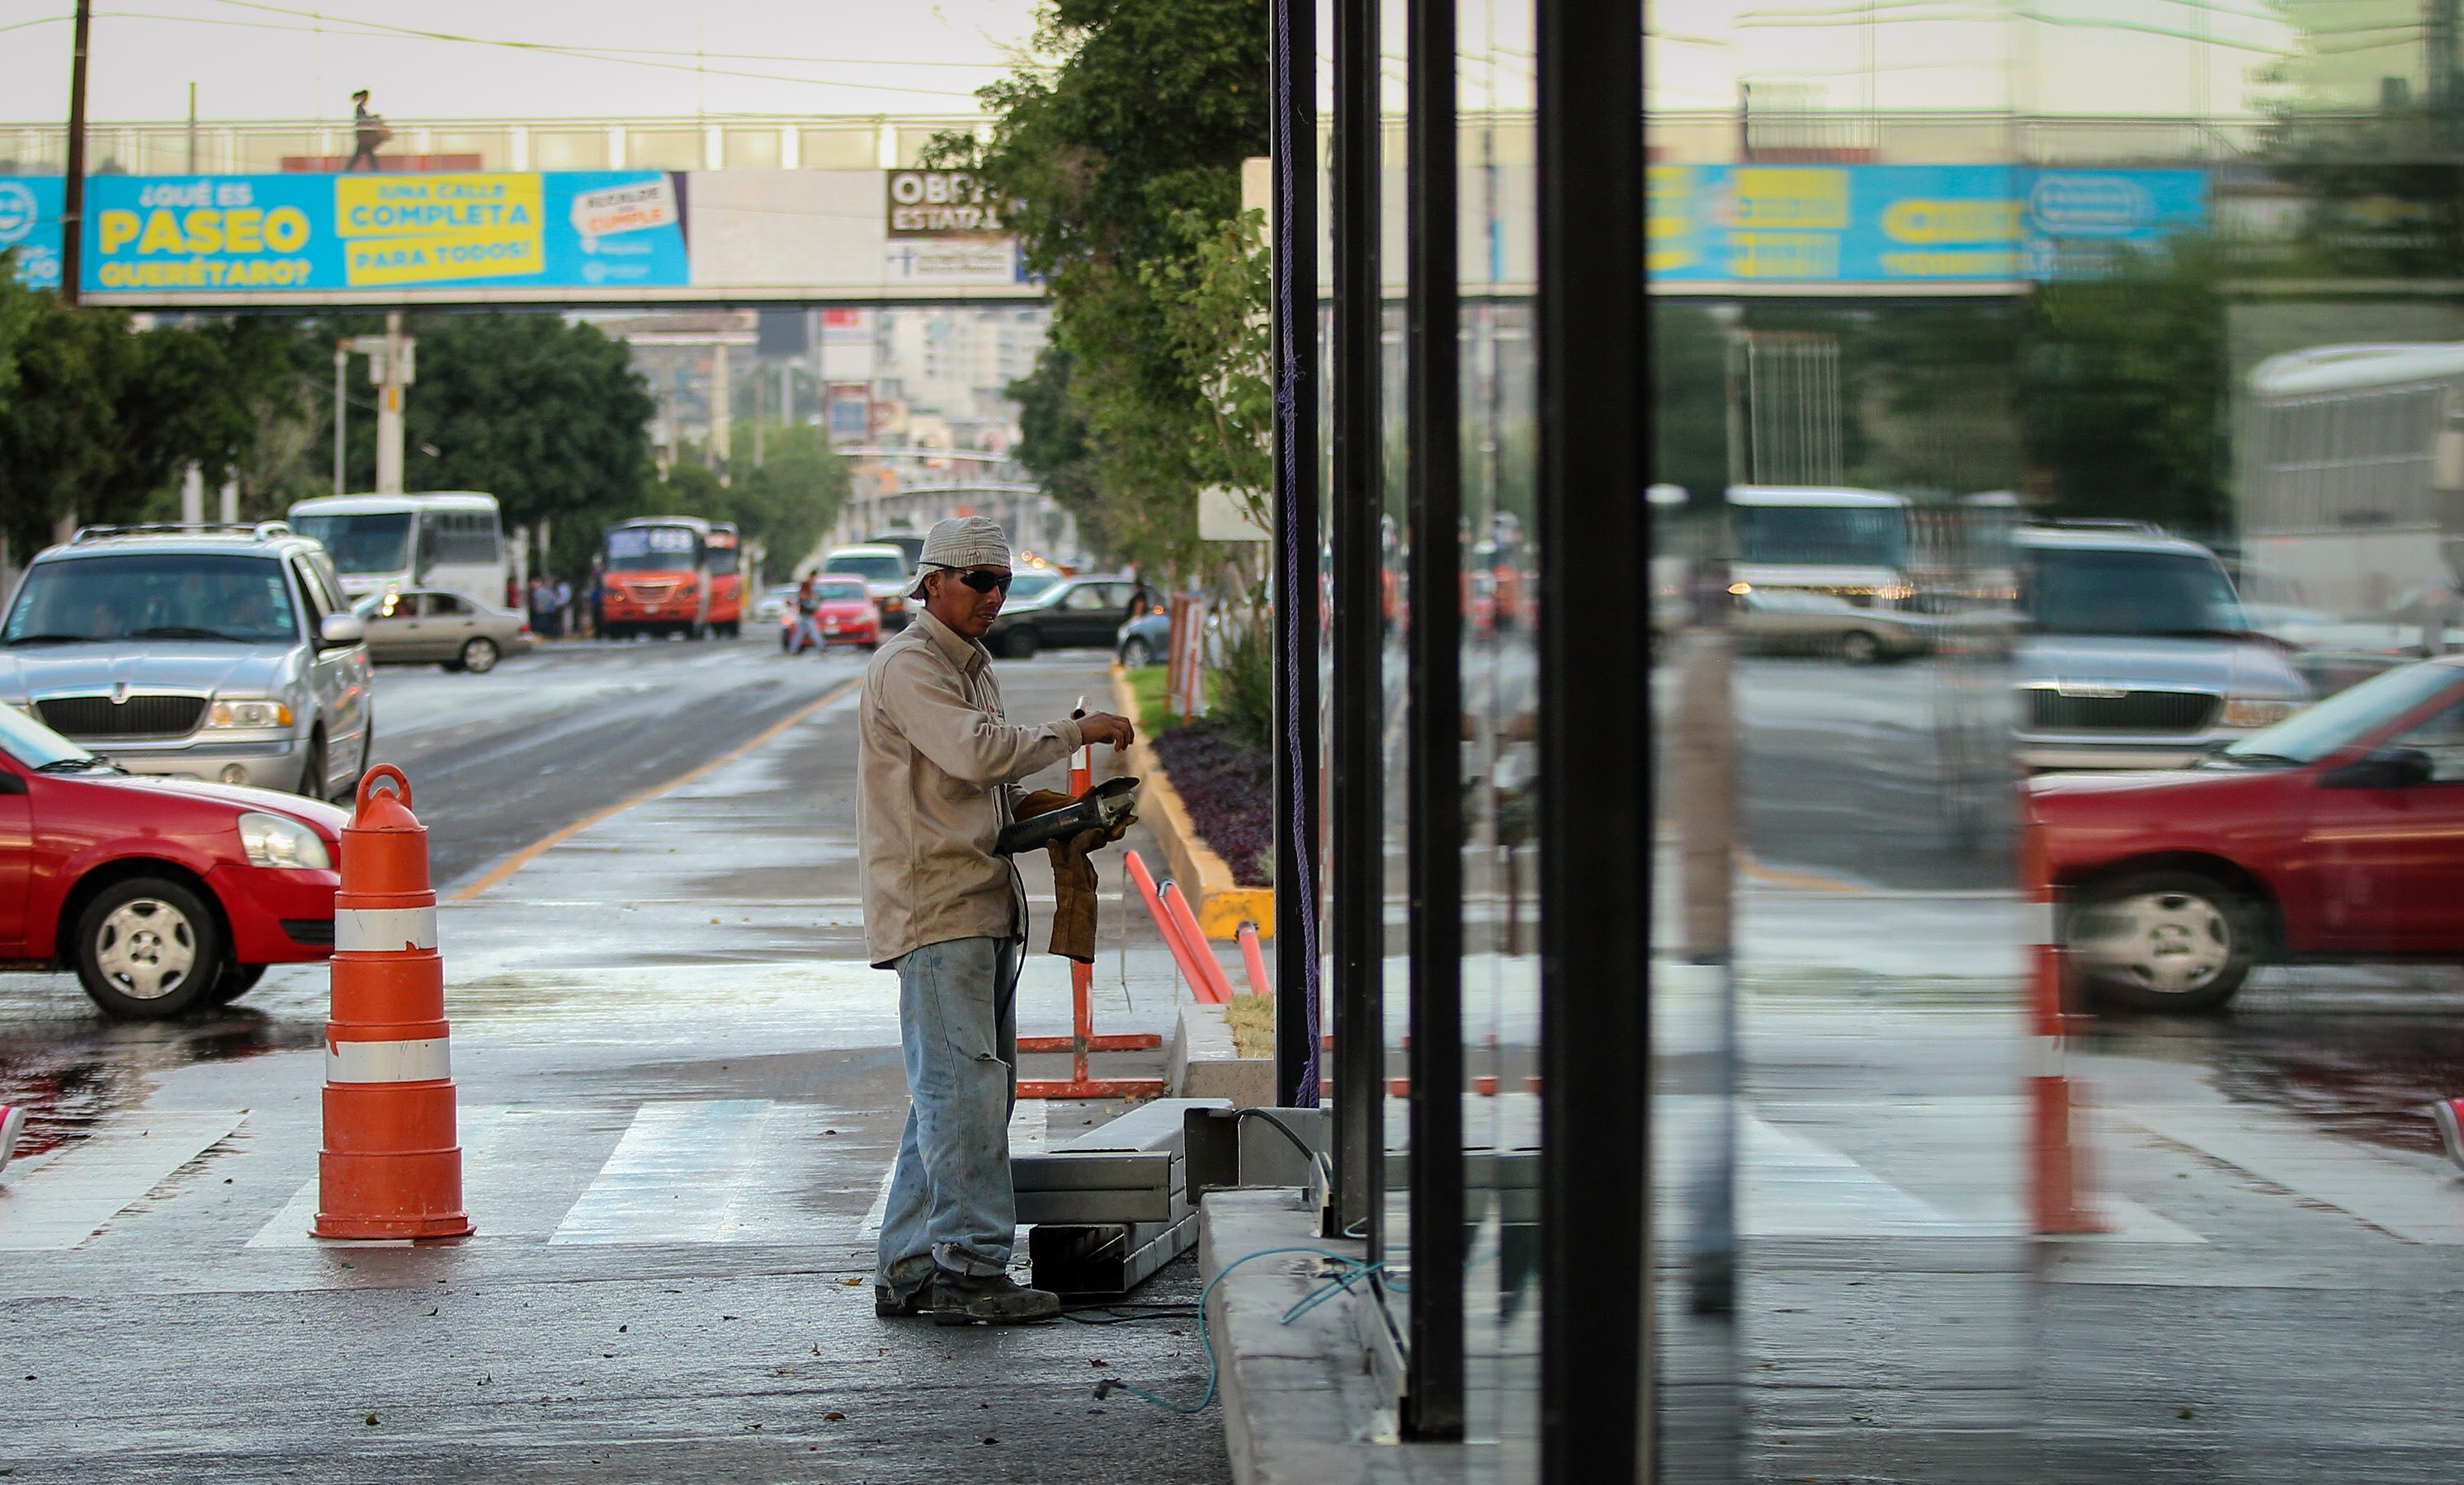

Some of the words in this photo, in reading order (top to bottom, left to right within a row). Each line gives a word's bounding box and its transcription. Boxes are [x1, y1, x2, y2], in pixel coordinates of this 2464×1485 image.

[139, 180, 212, 206] ¿QUÉ
[217, 183, 253, 205] ES
[437, 182, 506, 198] CALLE
[348, 202, 531, 227] COMPLETA
[892, 205, 1003, 231] ESTATAL
[98, 205, 311, 254] PASEO
[355, 249, 428, 270] PARA
[433, 240, 531, 263] TODOS!
[98, 255, 312, 286] QUERÉTARO?
